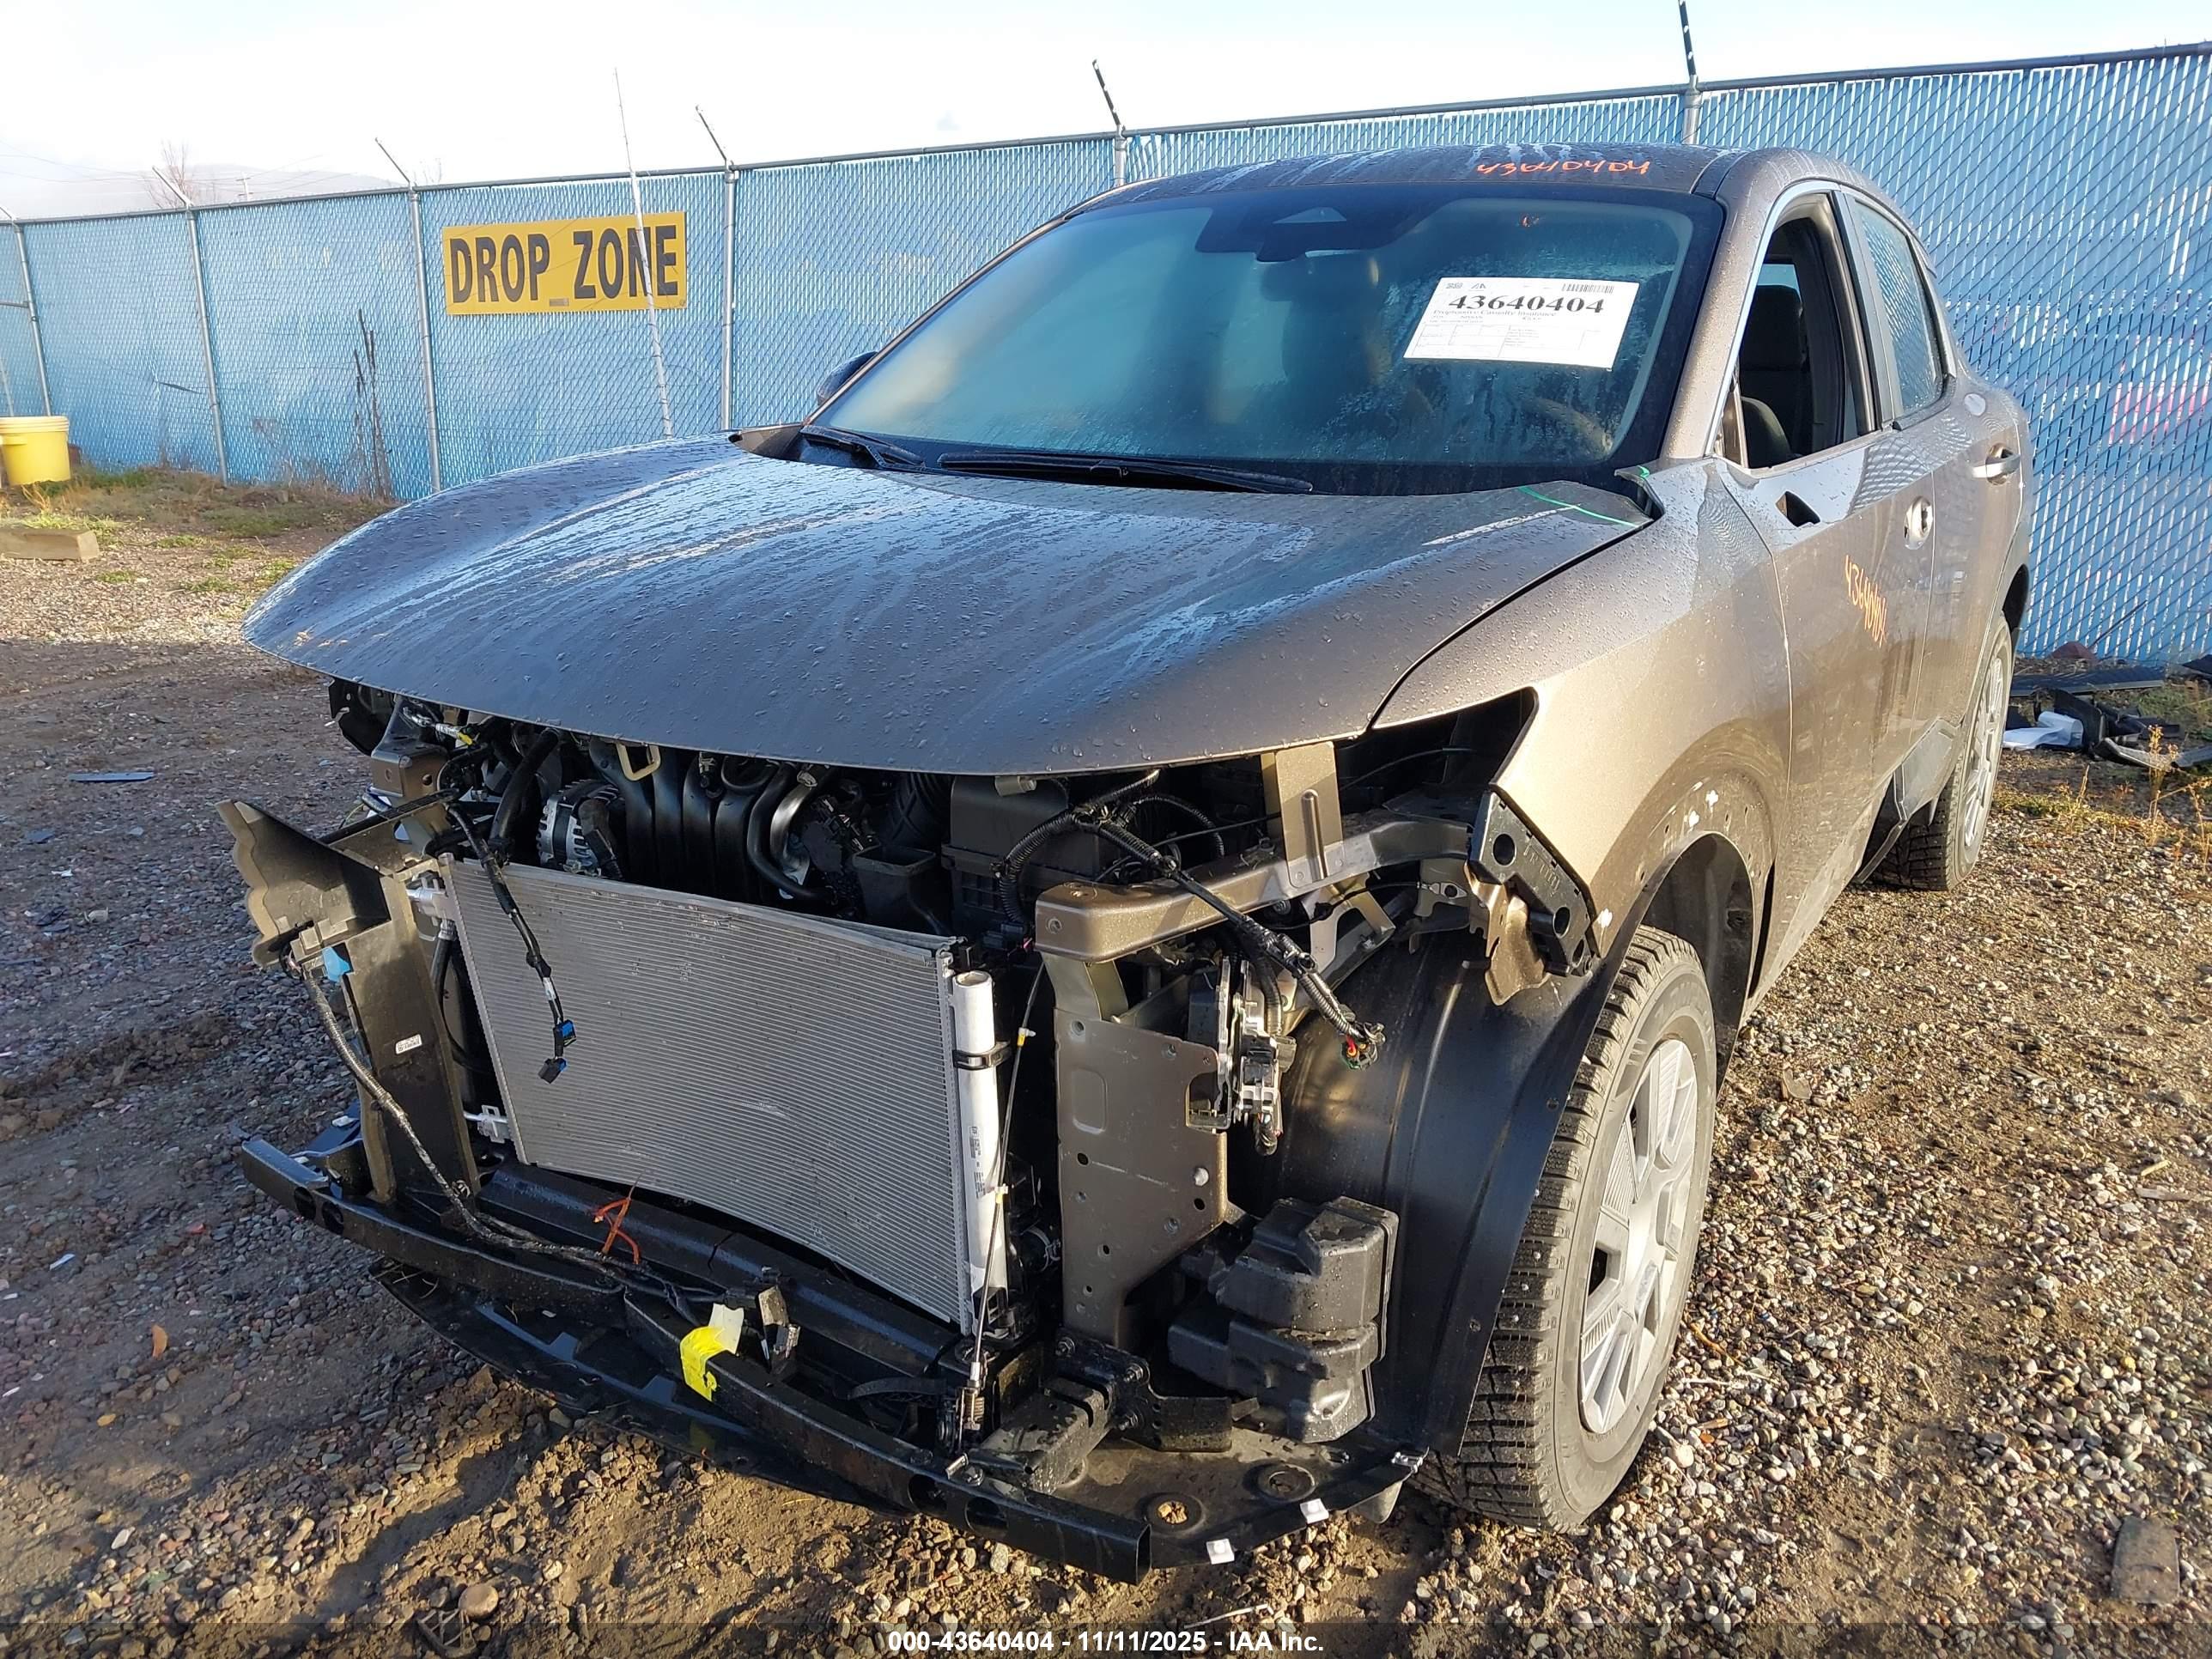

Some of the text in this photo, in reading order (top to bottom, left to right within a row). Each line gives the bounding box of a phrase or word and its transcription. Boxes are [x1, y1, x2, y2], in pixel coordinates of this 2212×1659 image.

[1477, 160, 1650, 176] 43640404
[450, 225, 678, 303] DROP ZONE
[1449, 295, 1604, 313] 43640404
